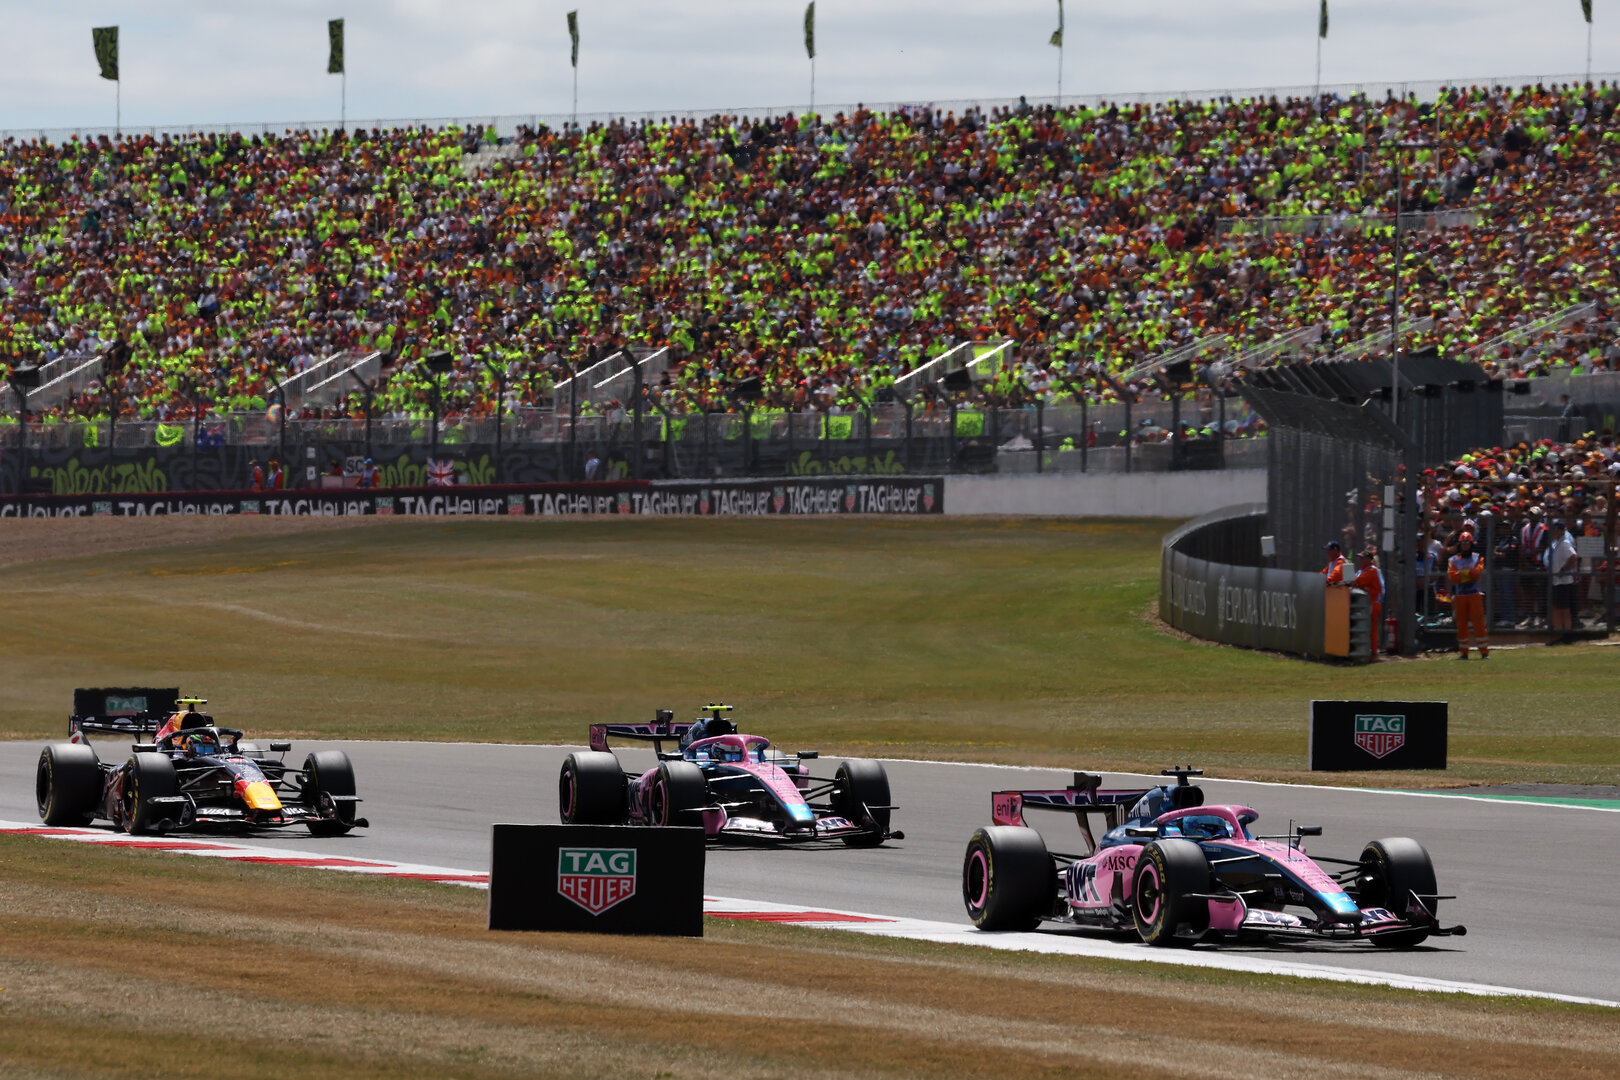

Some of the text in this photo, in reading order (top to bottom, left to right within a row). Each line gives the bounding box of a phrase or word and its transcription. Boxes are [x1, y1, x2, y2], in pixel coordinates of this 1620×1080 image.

[1359, 717, 1401, 731] TAG
[1357, 734, 1402, 756] HEUER
[565, 852, 630, 873] TAG
[1066, 861, 1102, 904] BWT
[562, 878, 632, 910] HEUER
